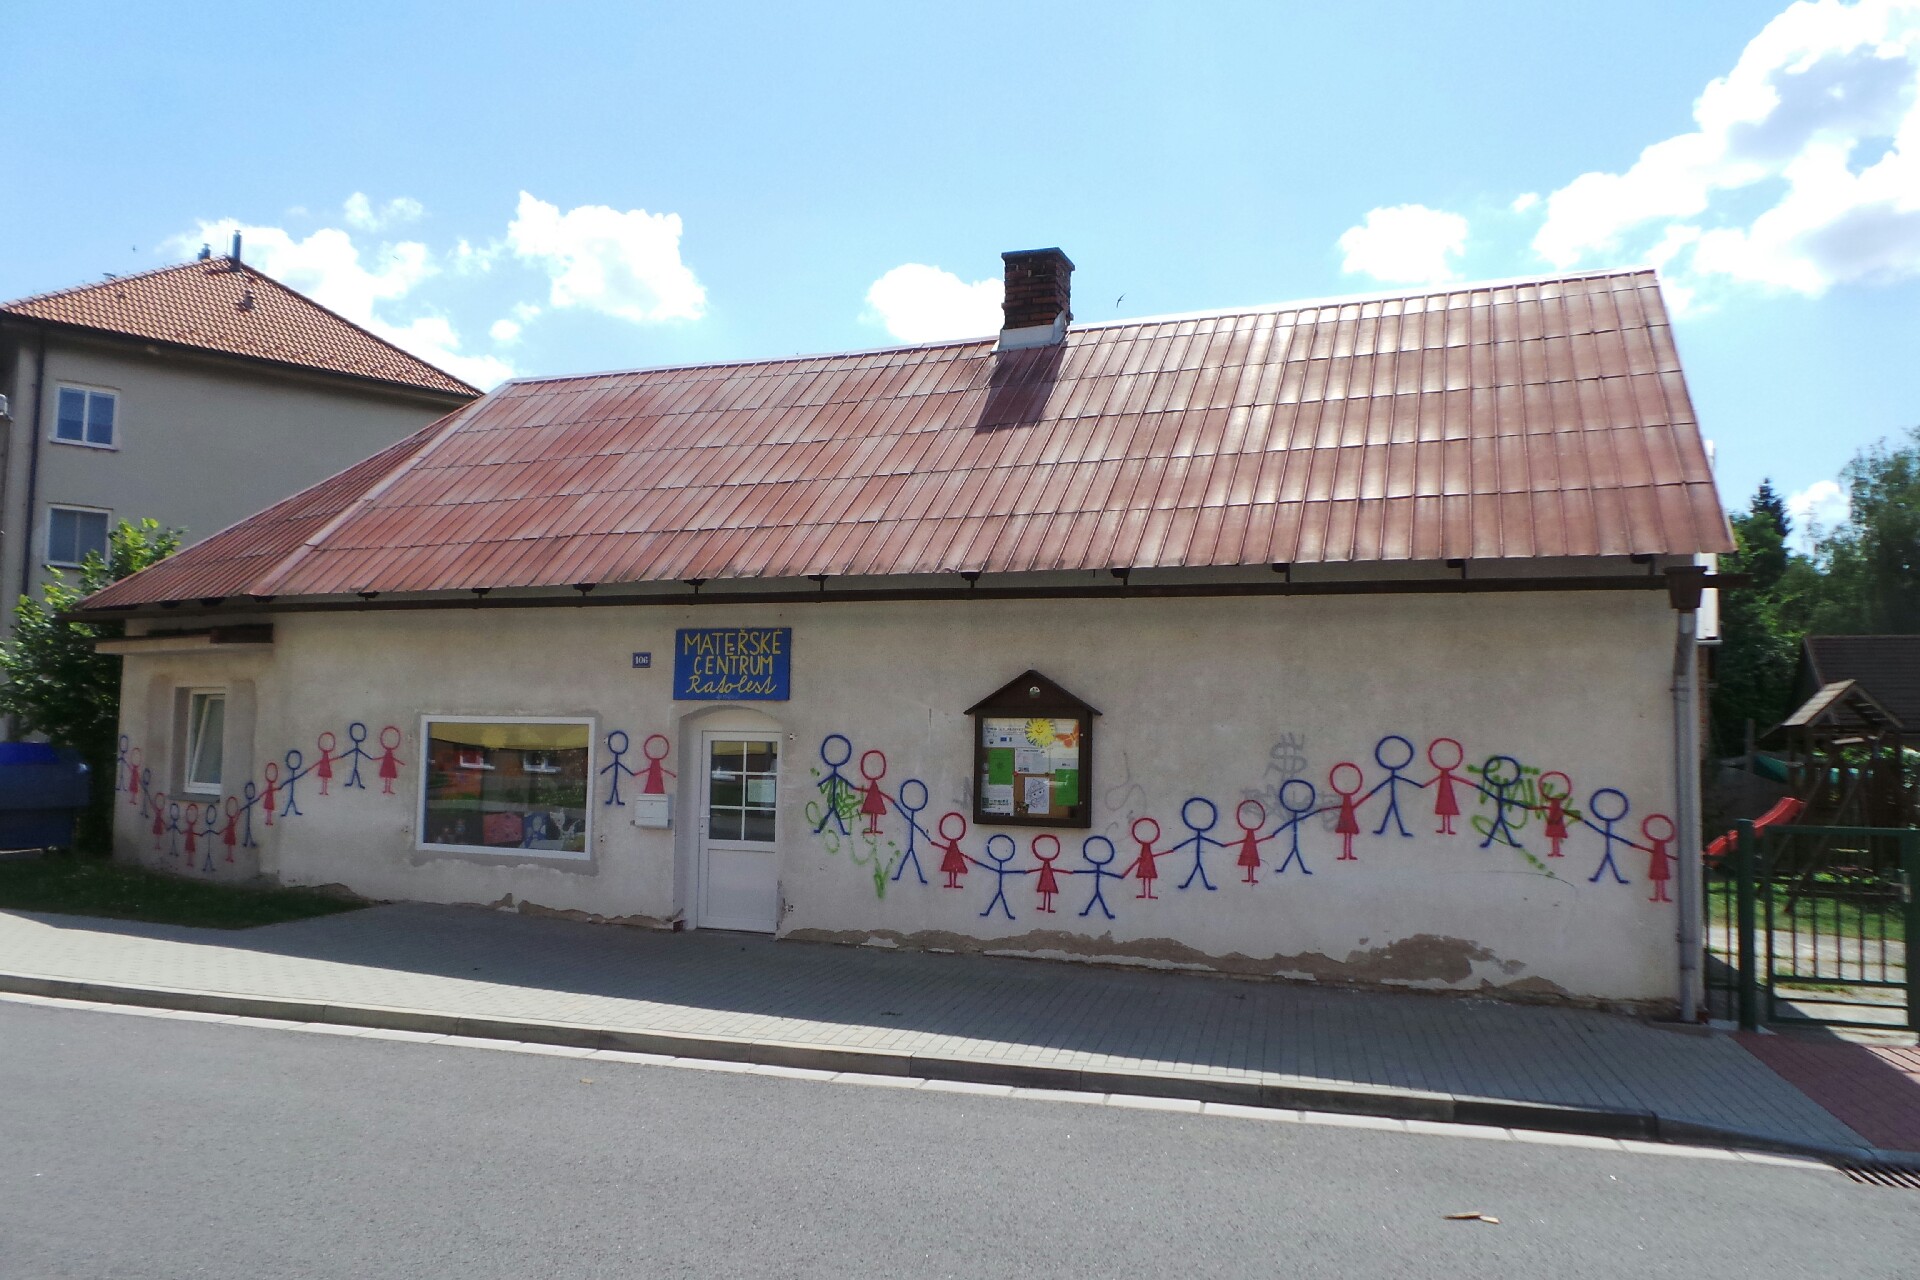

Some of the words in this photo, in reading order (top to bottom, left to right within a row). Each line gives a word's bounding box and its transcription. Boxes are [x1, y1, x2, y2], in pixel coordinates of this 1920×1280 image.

[635, 656, 649, 665] 106
[693, 655, 773, 676] CENTRUM
[686, 675, 777, 695] Ratolest
